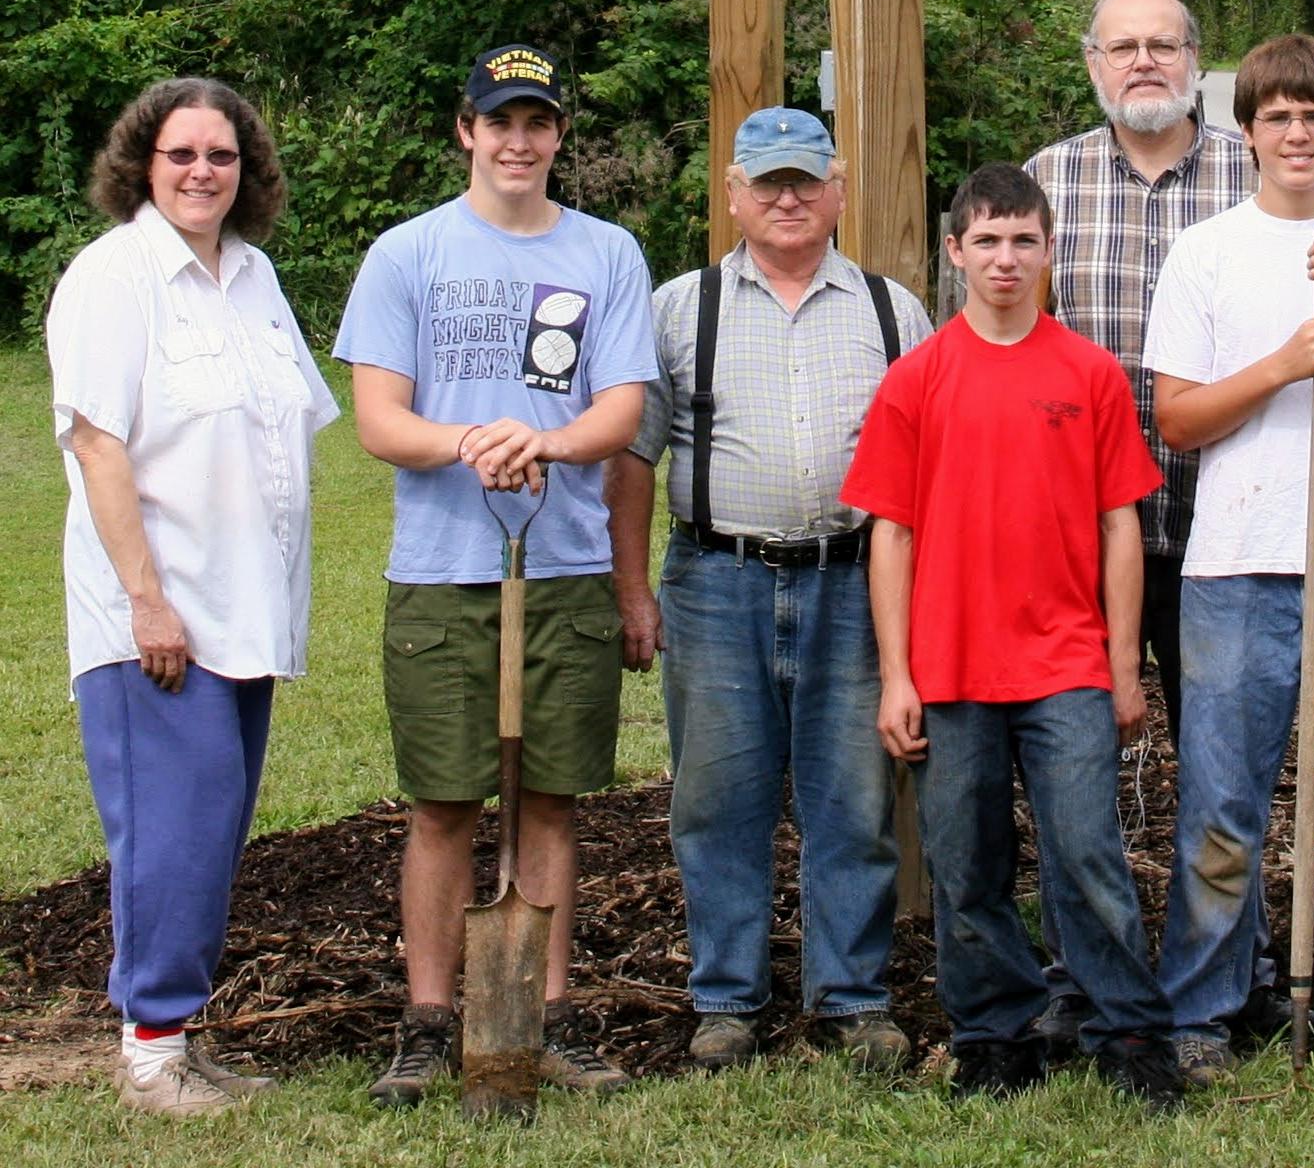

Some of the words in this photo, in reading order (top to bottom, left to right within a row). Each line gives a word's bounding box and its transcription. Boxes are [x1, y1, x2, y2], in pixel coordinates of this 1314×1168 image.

[485, 49, 554, 74] VIETNAM
[493, 68, 550, 85] VETERAN
[430, 279, 529, 312] FRIDAY
[431, 314, 527, 346] NIGHT
[434, 348, 523, 383] FRENZY
